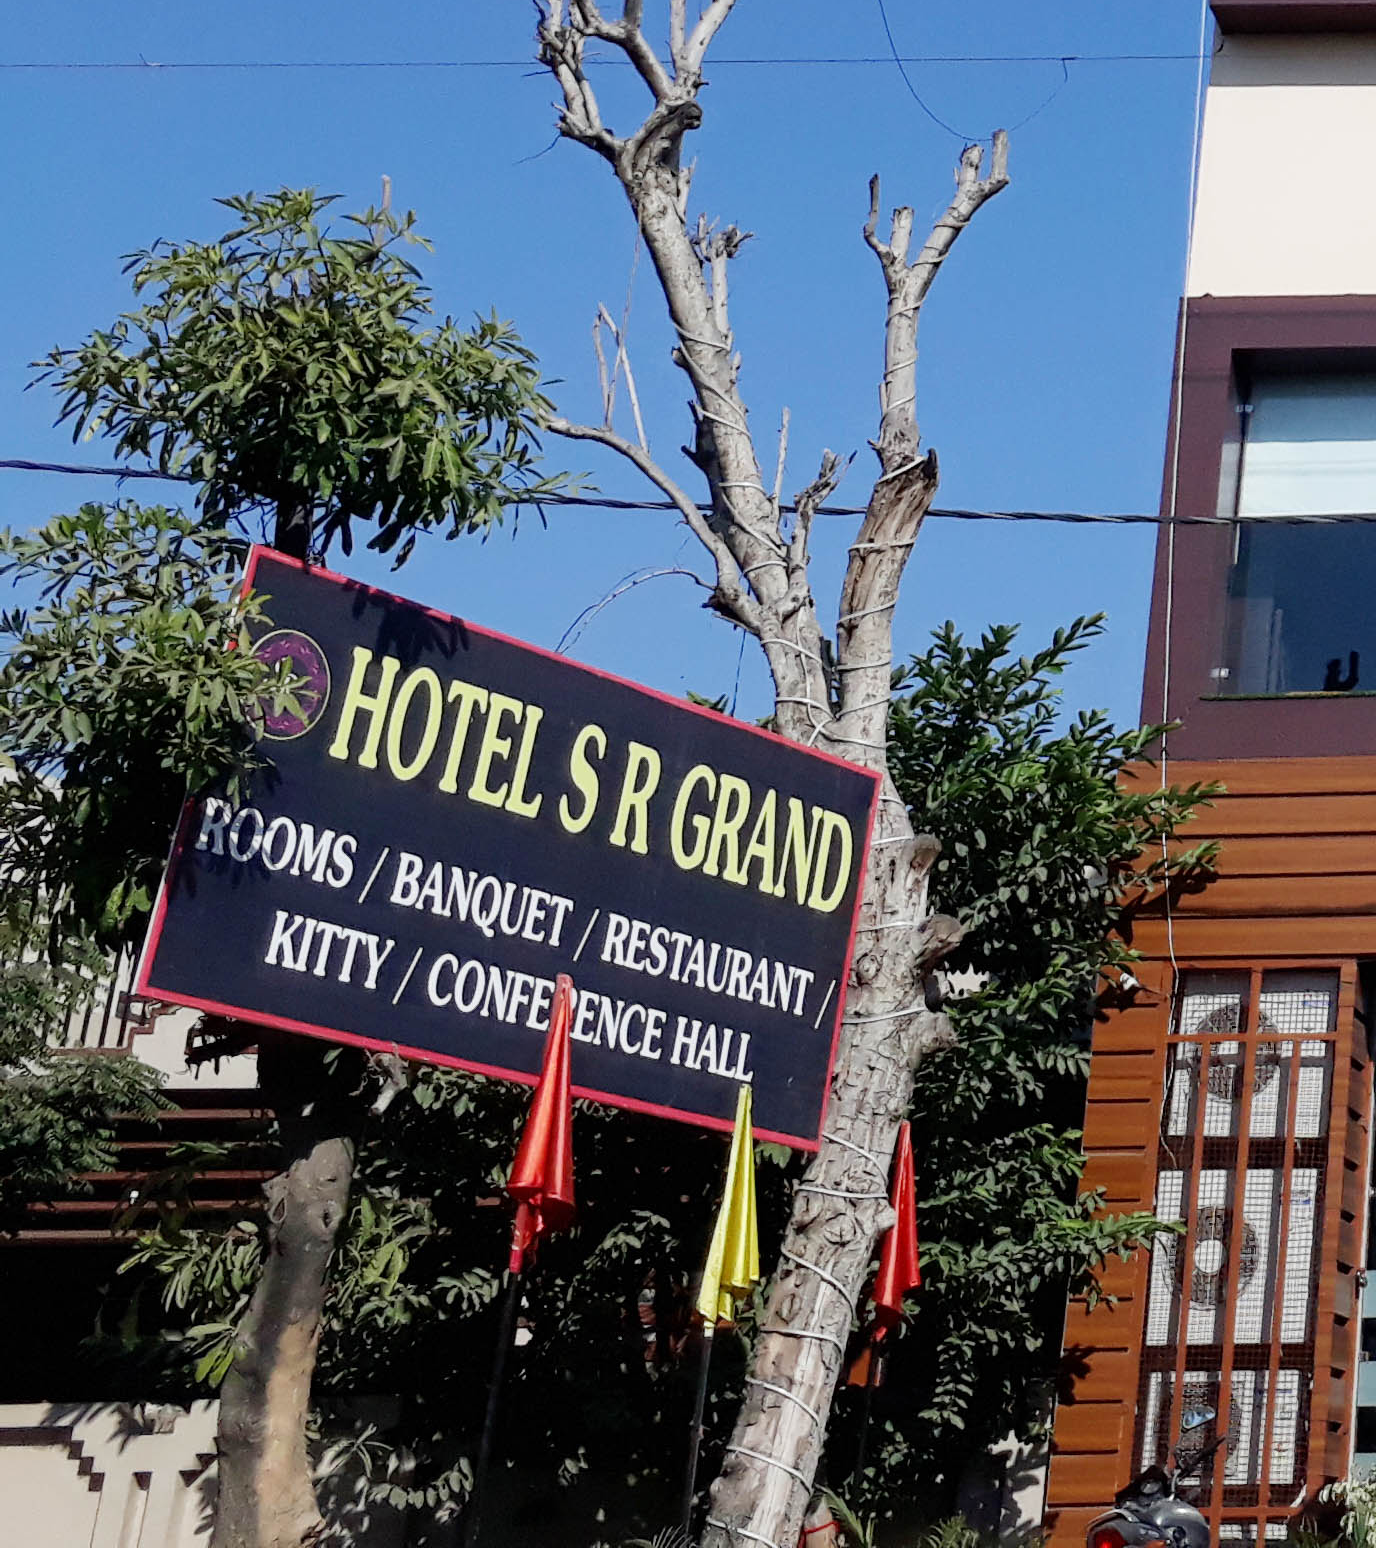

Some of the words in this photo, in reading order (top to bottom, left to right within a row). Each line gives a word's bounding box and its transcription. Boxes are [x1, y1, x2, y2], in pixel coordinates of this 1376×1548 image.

[329, 647, 544, 819] HOTEL
[559, 724, 607, 834] S
[610, 742, 661, 854] R
[669, 765, 854, 913] GRAND
[195, 797, 358, 889] ROOMS
[389, 851, 574, 947] BANQUET
[600, 912, 815, 1016] RESTAURANT
[264, 910, 396, 990] KITTY
[427, 953, 667, 1060] CONFEENCE
[669, 1015, 754, 1083] HALL
